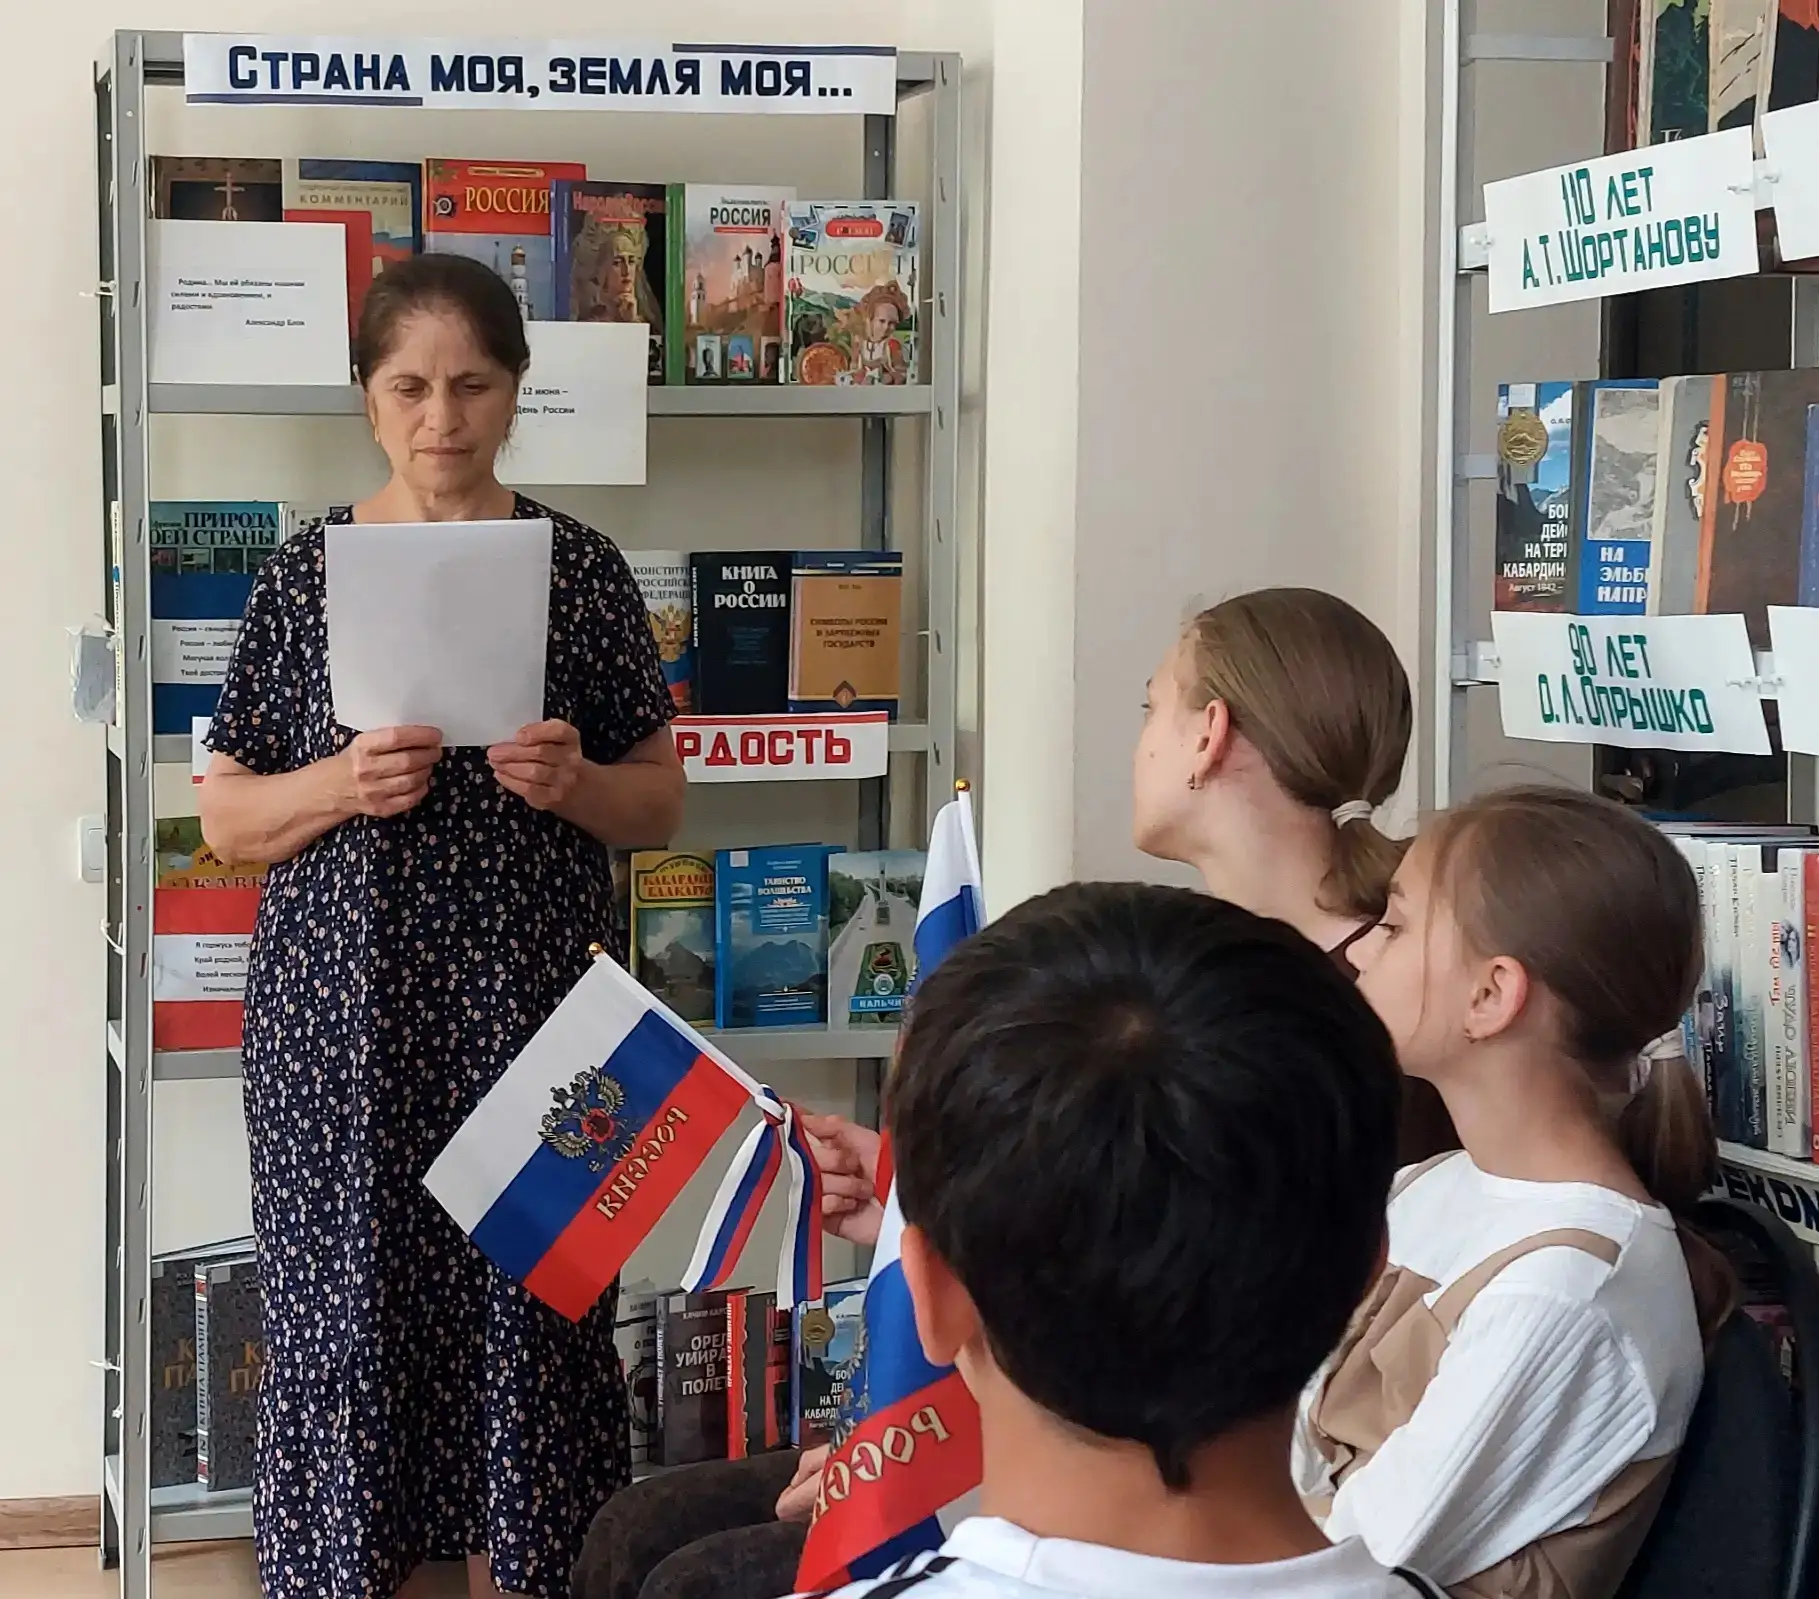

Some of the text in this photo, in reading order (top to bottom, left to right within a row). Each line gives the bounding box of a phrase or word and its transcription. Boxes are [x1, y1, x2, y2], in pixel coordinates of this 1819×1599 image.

[228, 45, 853, 99] СТРАНА МОЯ, ЗЕМЛЯ МОЯ...
[299, 194, 409, 207] КОММЕНТАРИЙ
[464, 185, 550, 215] РОССИЯ
[1560, 165, 1654, 228] 110 ЛЕТ
[710, 206, 772, 227] РОССИЯ
[245, 319, 306, 327] Александр Блок
[522, 387, 533, 395] 12
[543, 406, 576, 415] России
[183, 511, 277, 529] ПРИРОДА
[192, 529, 277, 546] СТРАНЫ
[1524, 542, 1542, 559] НА
[1600, 546, 1624, 563] НА
[721, 565, 779, 581] КНИГА
[1503, 562, 1567, 581] КАБАРДИН
[743, 580, 756, 595] О
[713, 593, 787, 609] РОССИИ
[1568, 622, 1652, 679] 90 ЛЕТ
[859, 998, 904, 1009] НАЛЬЧИ
[706, 1363, 716, 1378] В
[820, 1395, 831, 1406] НА
